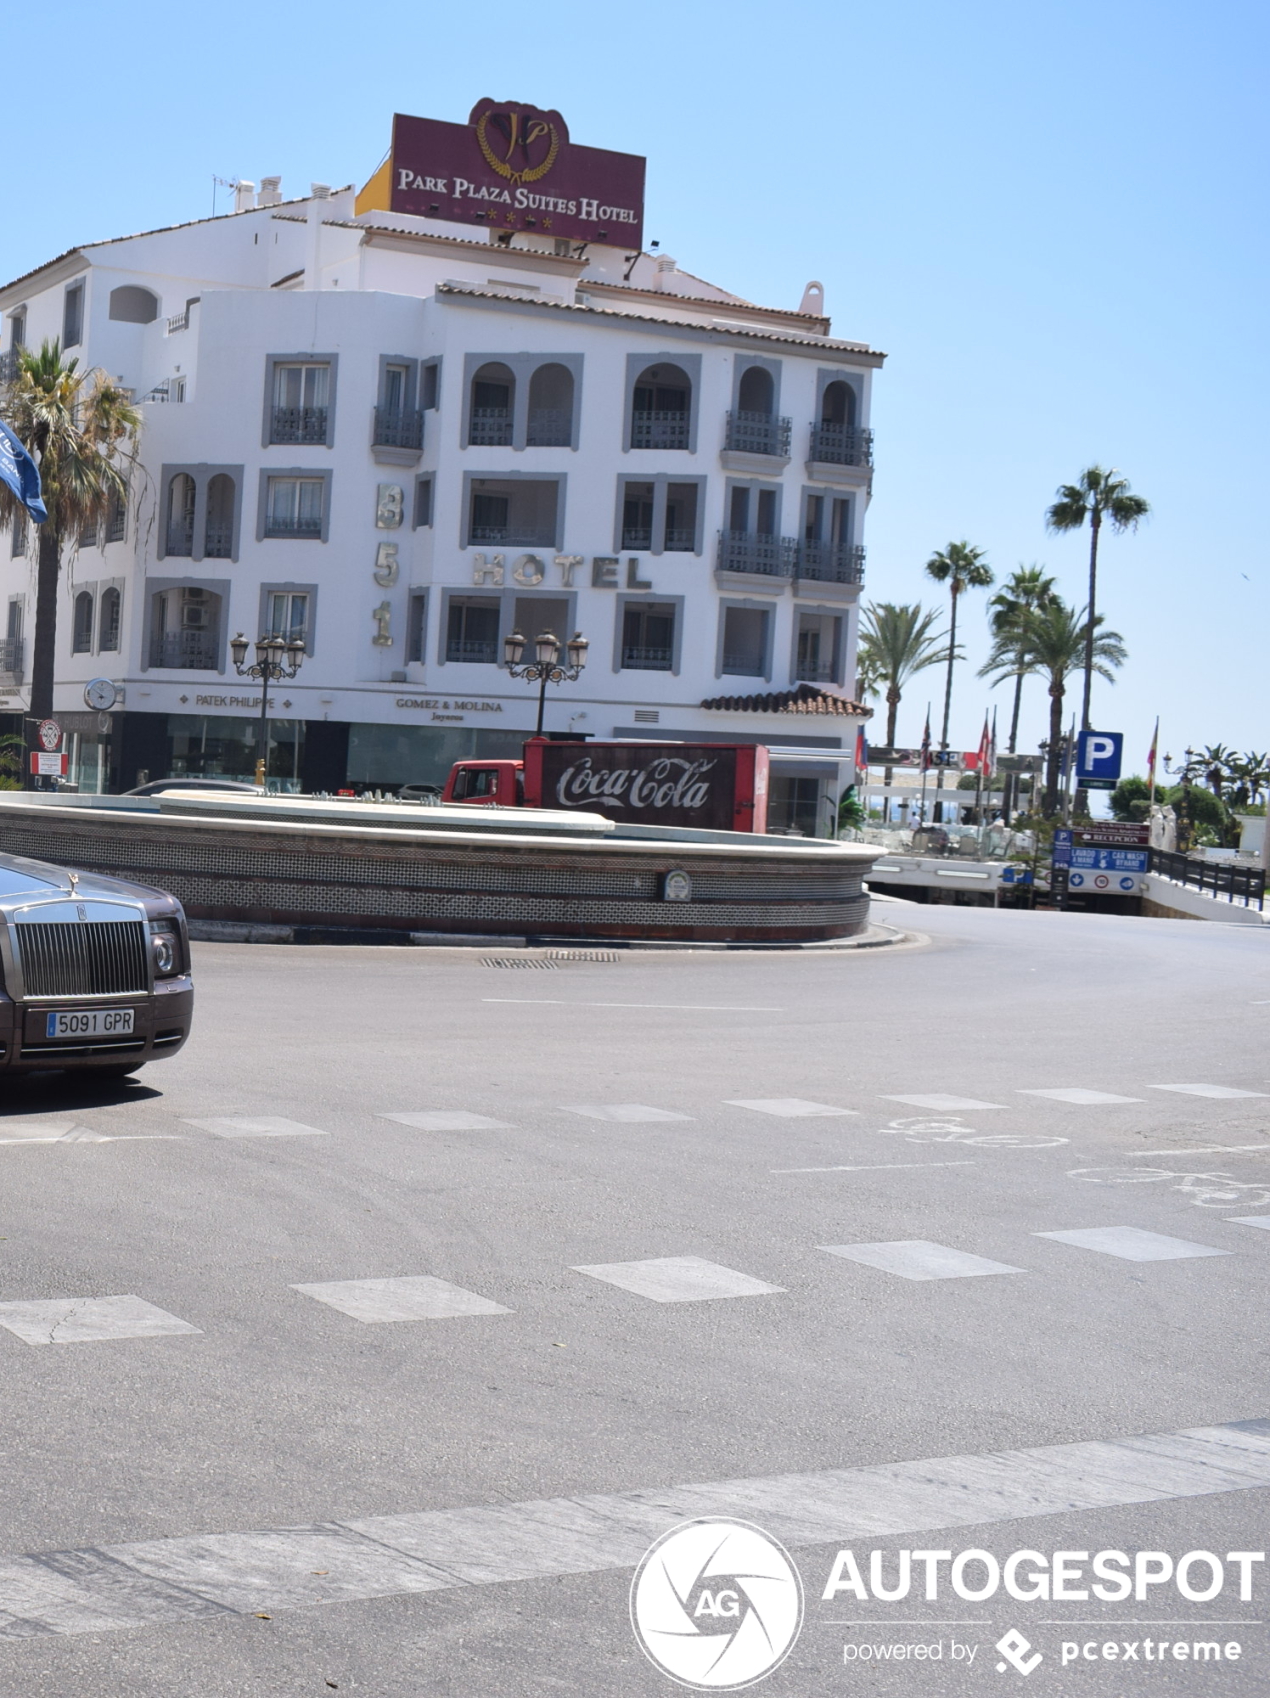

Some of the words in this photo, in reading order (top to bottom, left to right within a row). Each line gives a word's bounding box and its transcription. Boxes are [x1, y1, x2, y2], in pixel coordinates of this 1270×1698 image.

[397, 169, 448, 194] PARK
[452, 177, 511, 205] PLAZA
[514, 188, 577, 215] SUITES
[578, 197, 638, 225] HOTEL
[473, 553, 653, 590] HOTEL
[196, 694, 228, 707] PATEK
[230, 696, 276, 708] PHILIPPE
[395, 698, 439, 710] GOMEZ
[442, 700, 451, 710] &
[454, 701, 503, 712] MOLINA
[1084, 736, 1115, 771] P
[1060, 832, 1067, 840] P
[1112, 852, 1126, 860] CAR
[1126, 852, 1145, 861] WASH
[59, 1015, 97, 1033] 5091
[104, 1012, 132, 1030] GPR
